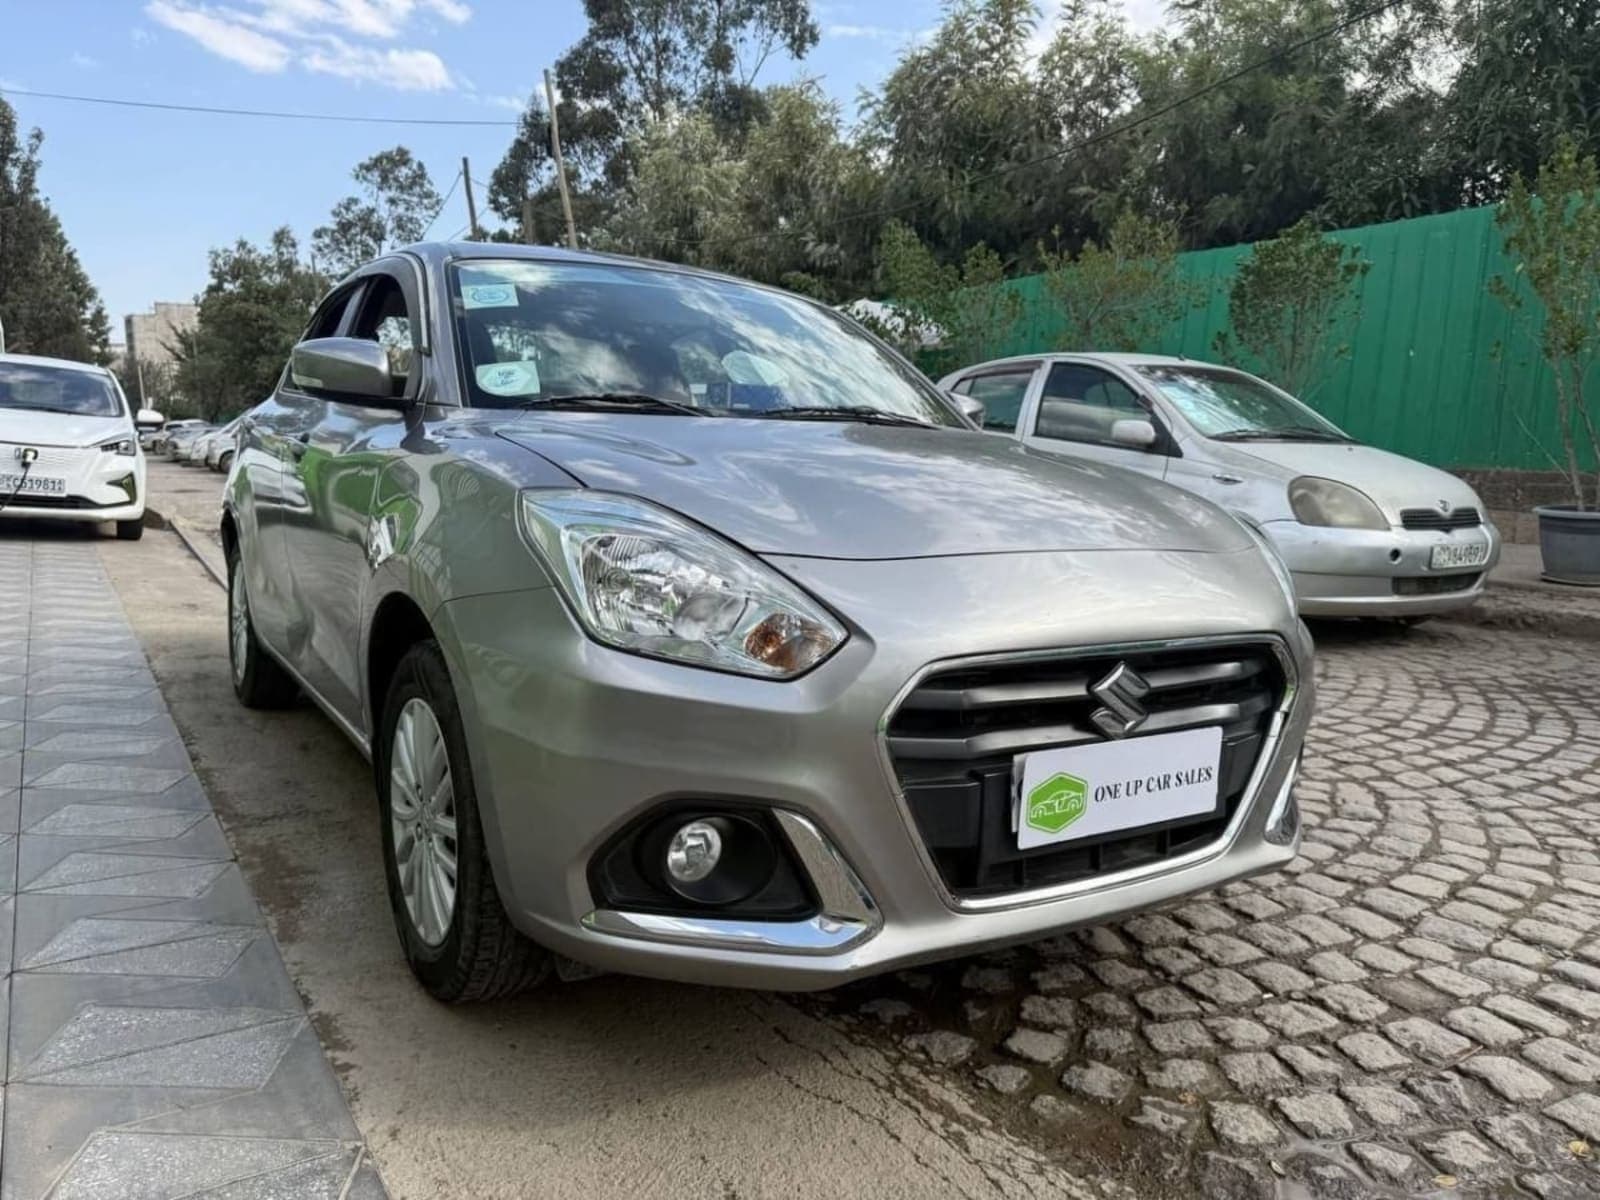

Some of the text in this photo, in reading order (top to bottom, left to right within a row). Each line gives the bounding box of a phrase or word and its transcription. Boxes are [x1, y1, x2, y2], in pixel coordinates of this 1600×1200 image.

[1094, 766, 1213, 802] ONE UP CAR SALES
